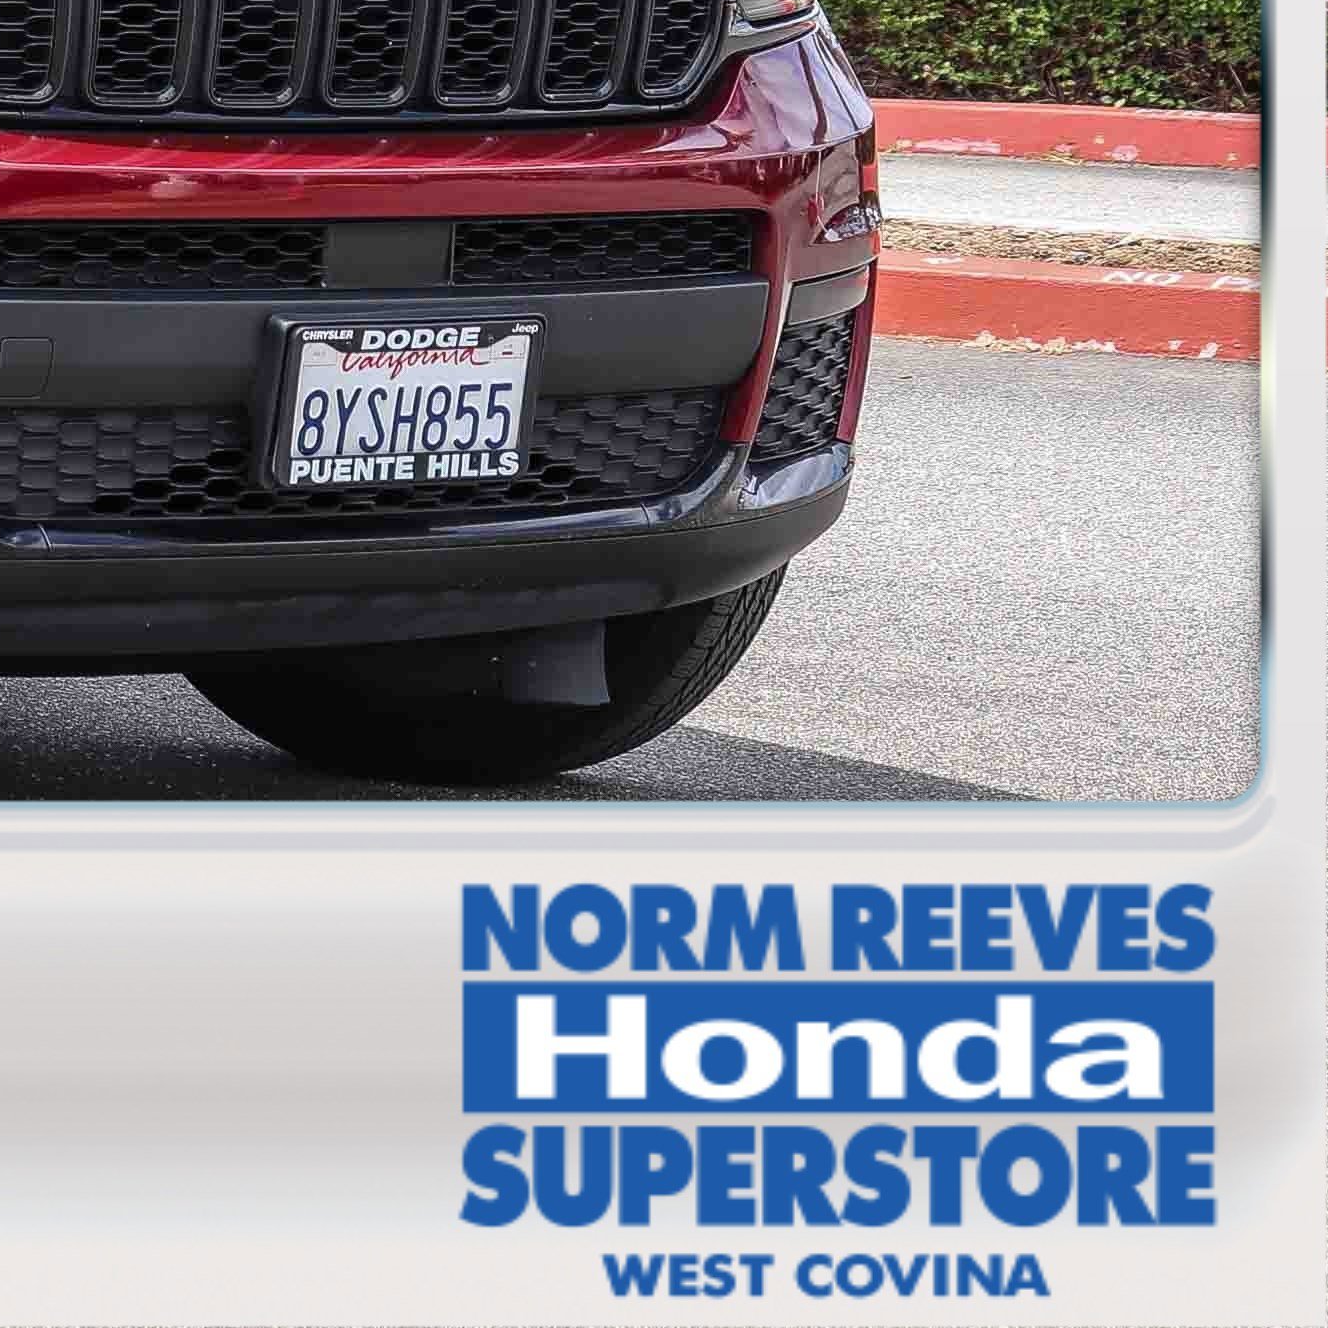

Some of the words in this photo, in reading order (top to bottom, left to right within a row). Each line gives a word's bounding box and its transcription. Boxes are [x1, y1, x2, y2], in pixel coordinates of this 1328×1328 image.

[302, 328, 355, 341] CHRYSLER
[360, 326, 482, 351] DODGE
[511, 322, 540, 334] Jeep
[342, 346, 490, 379] California
[297, 382, 513, 457] 8YSH855
[288, 454, 416, 485] PUENTE
[426, 449, 520, 479] HILLS
